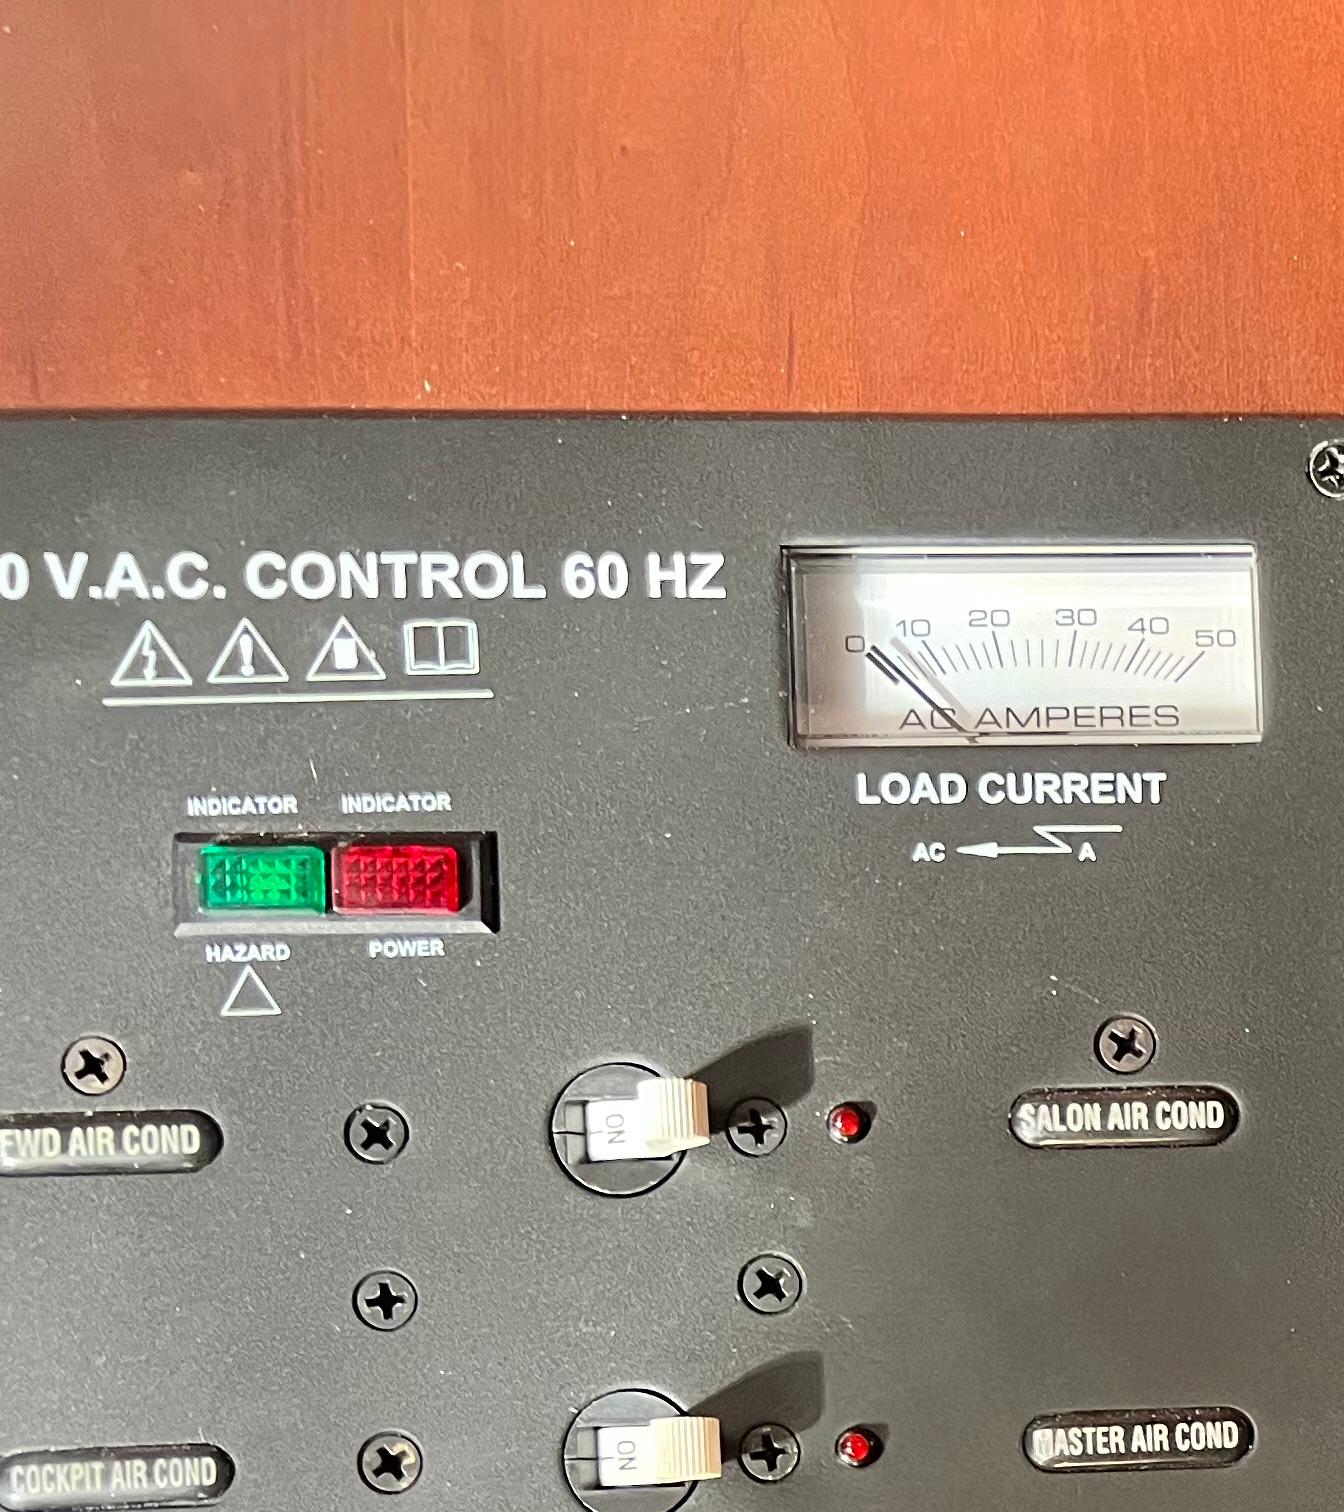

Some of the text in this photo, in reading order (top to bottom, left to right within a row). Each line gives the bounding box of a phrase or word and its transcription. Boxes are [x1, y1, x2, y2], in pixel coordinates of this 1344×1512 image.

[43, 551, 226, 600] V.A.C.
[246, 551, 546, 600] CONTROL
[564, 551, 628, 599] 60
[648, 552, 727, 599] HZ
[897, 619, 931, 638] 10
[969, 610, 1011, 627] 20
[1055, 609, 1097, 627] 30
[1128, 617, 1170, 635] 40
[845, 636, 865, 653] 0
[1194, 629, 1236, 648] 50
[899, 704, 1180, 730] AC AMPERES
[857, 772, 1167, 805] LOAD CURRENT
[187, 794, 298, 816] INDICATOR
[341, 792, 452, 814] INDICATOR
[912, 843, 946, 862] AC
[1078, 843, 1097, 862] A
[205, 943, 290, 963] HAZARD
[369, 938, 444, 958] POWER
[1020, 1099, 1225, 1133] SALON AIR COND
[605, 1113, 626, 1144] ON
[0, 1124, 200, 1157] FWD AIR COND
[1032, 1420, 1239, 1457] MASTER AIR COND
[617, 1441, 637, 1472] ON
[10, 1457, 217, 1494] COCKPIT AIR COND
